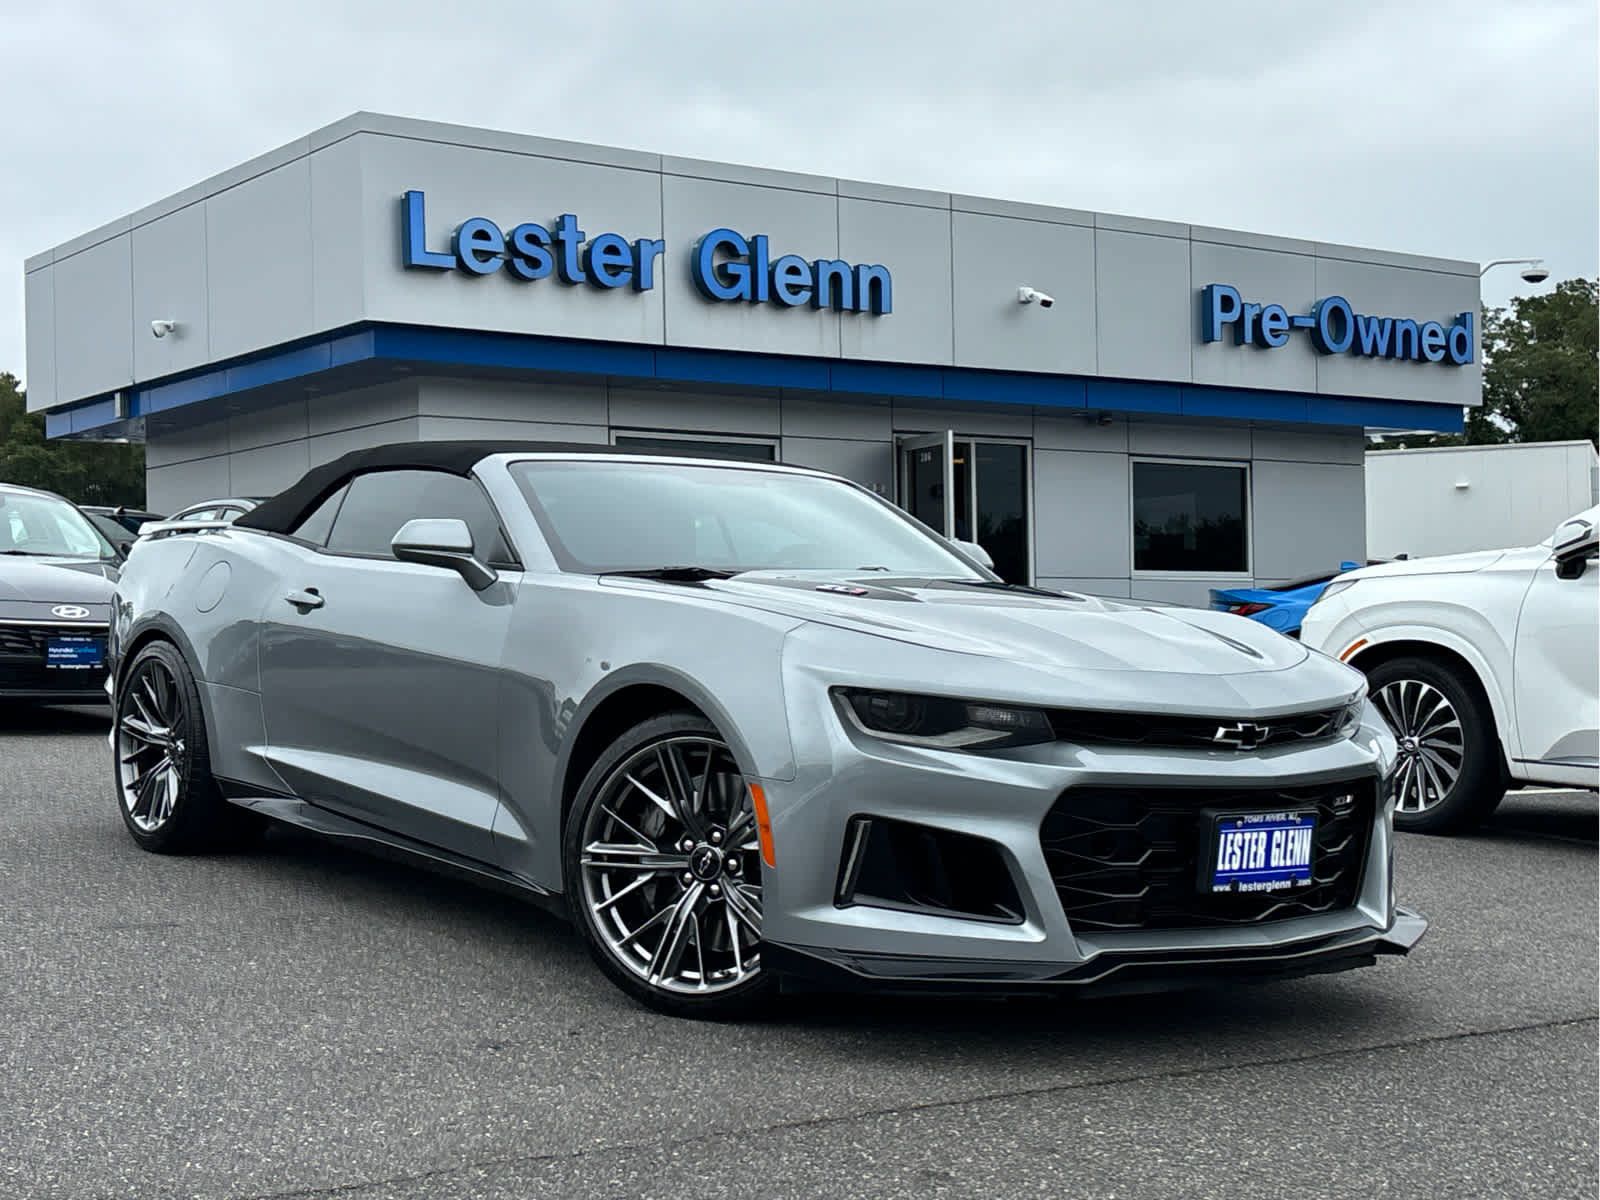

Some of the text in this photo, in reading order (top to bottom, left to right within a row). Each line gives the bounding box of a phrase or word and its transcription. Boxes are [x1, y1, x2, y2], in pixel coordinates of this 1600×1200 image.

[402, 190, 893, 315] Lester Glenn
[1202, 283, 1474, 366] Pre-Owned
[1217, 828, 1312, 871] LESTER GLENN
[1238, 880, 1292, 893] lesterglenn
